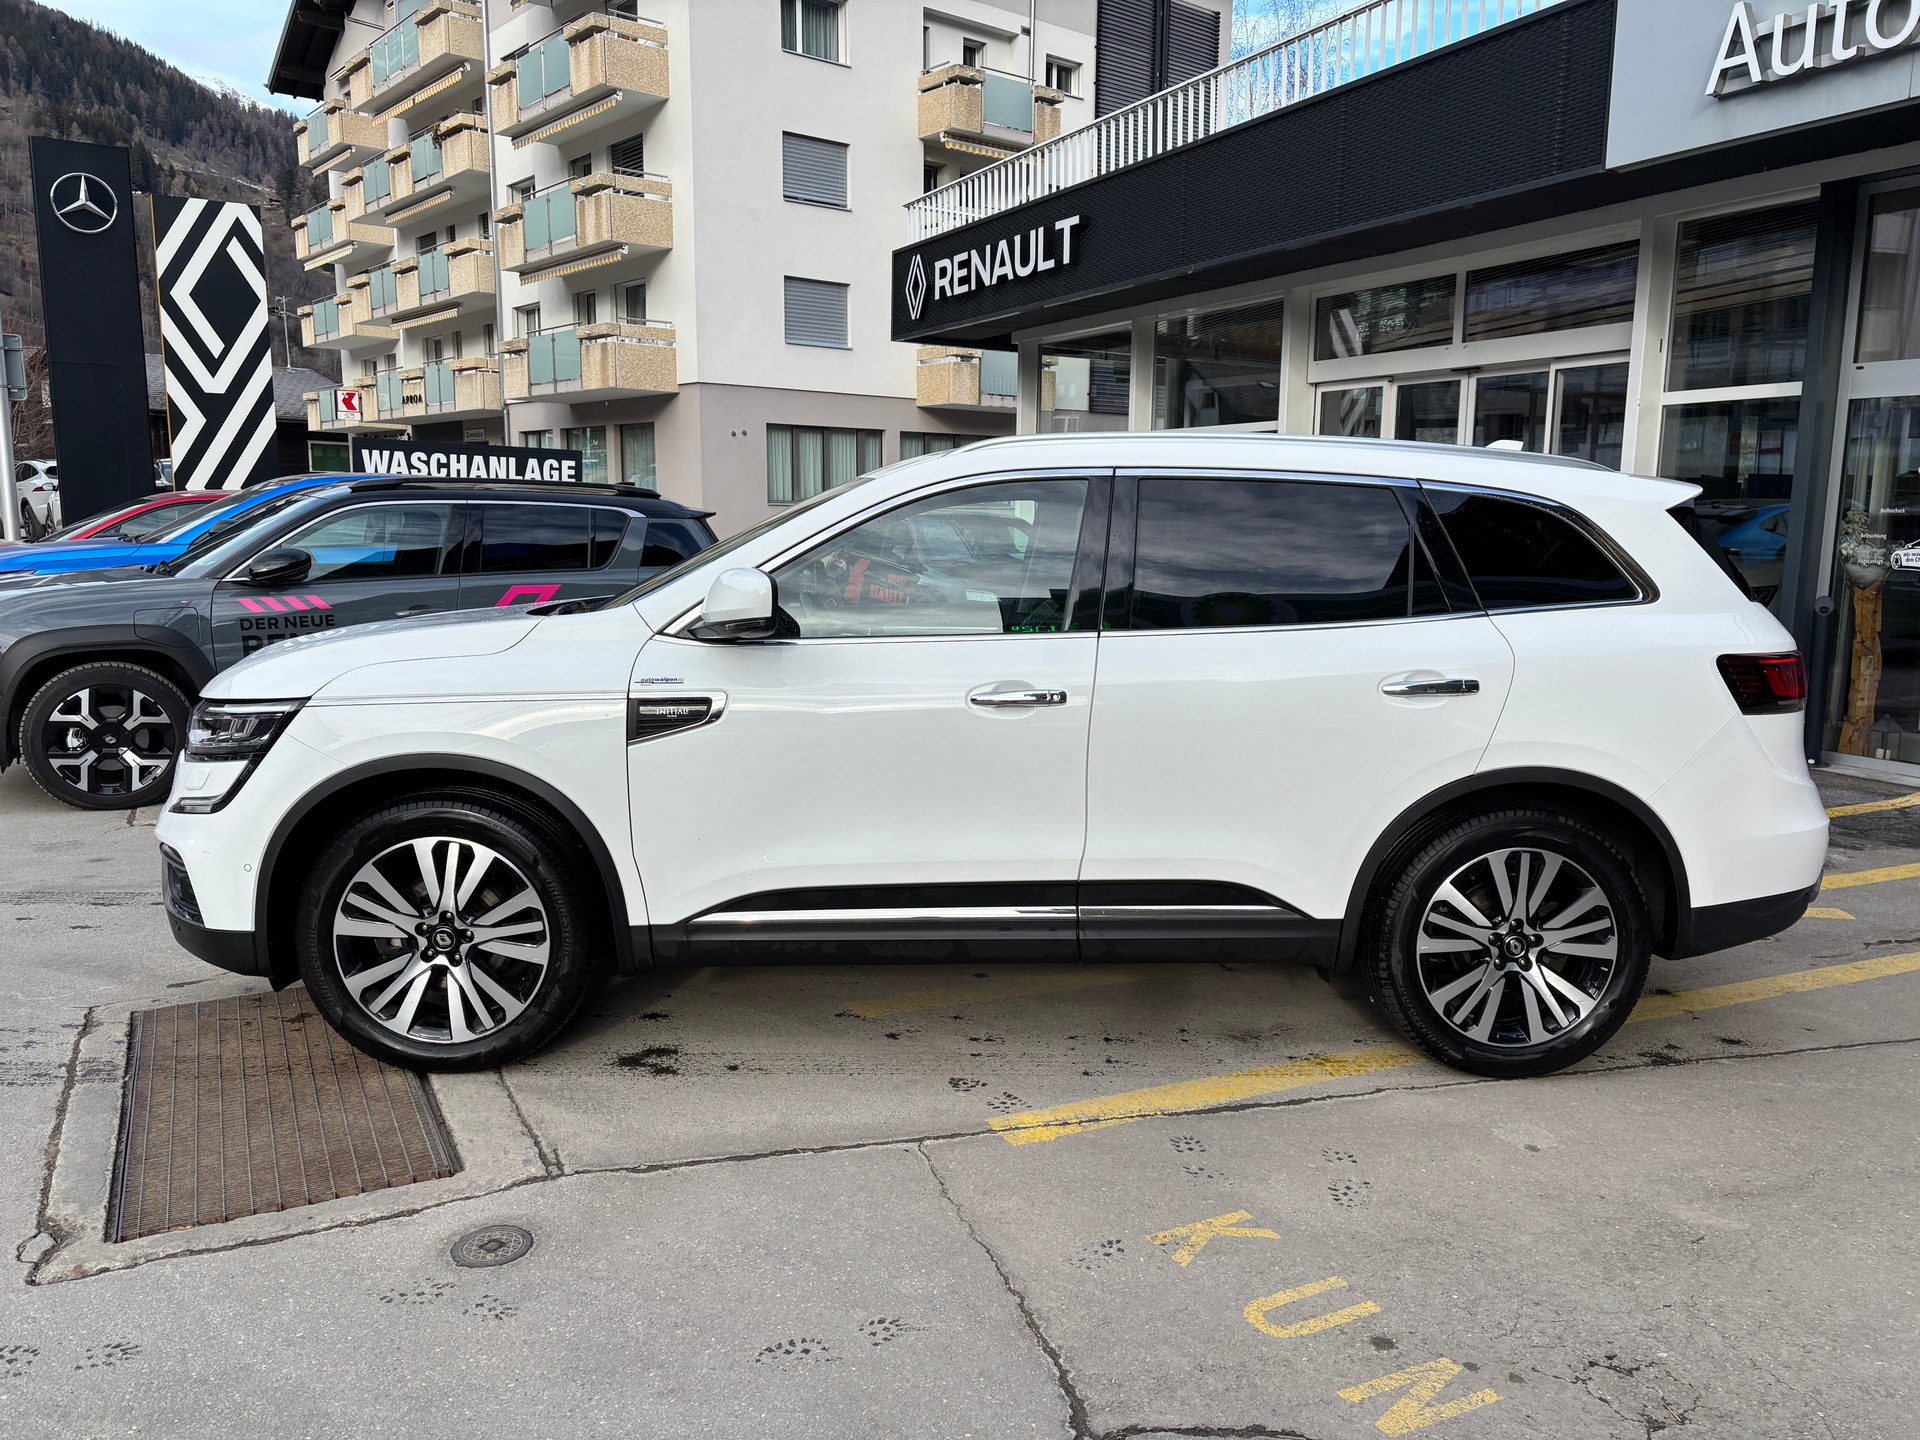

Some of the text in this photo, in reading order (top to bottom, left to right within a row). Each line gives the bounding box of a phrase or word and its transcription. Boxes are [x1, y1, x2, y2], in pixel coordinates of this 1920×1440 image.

[1704, 0, 1920, 97] Auto
[934, 214, 1080, 300] RENAULT
[361, 449, 576, 482] WASCHANLAGE
[239, 614, 336, 631] DER NEUE
